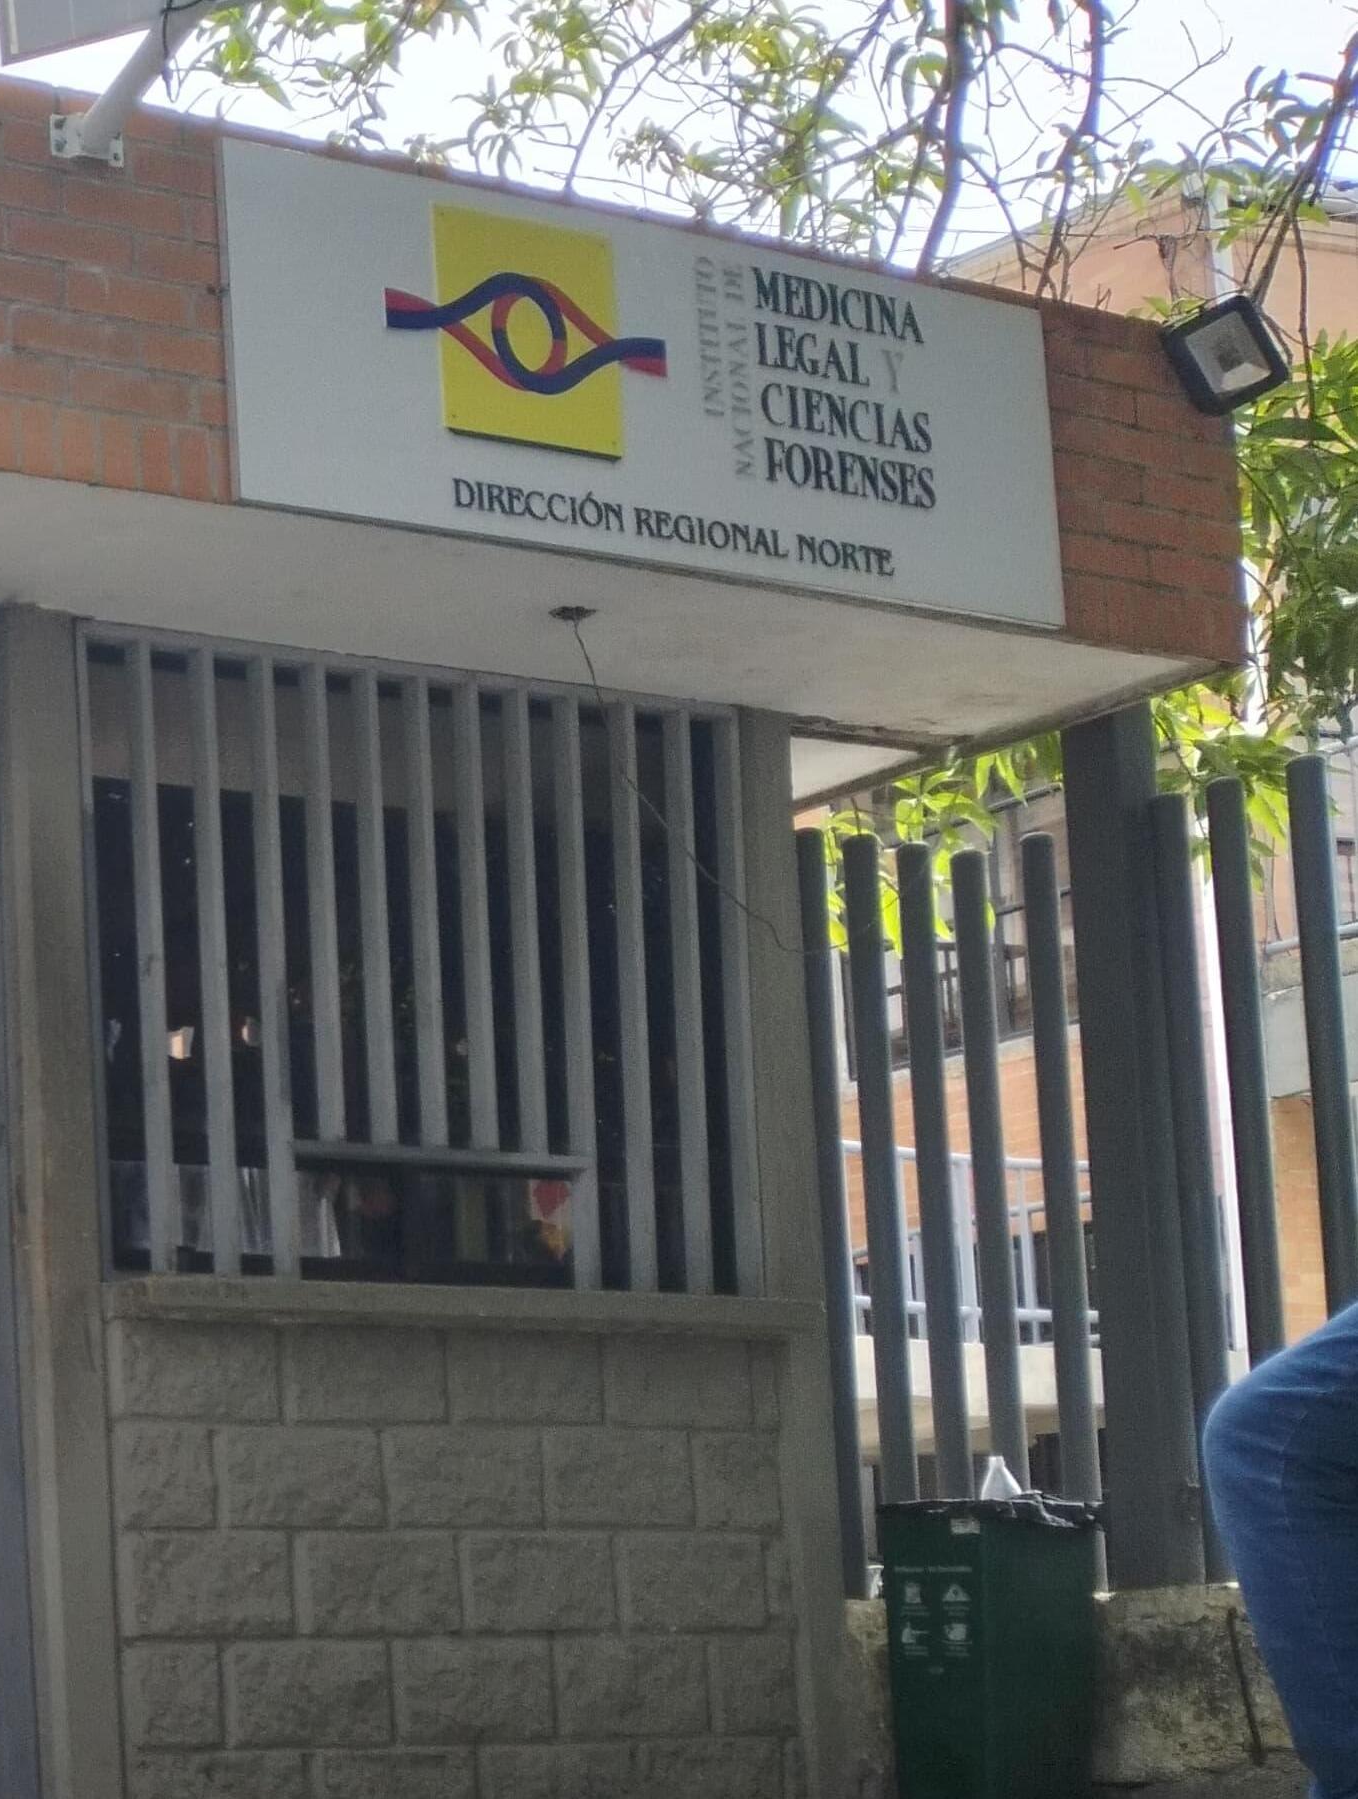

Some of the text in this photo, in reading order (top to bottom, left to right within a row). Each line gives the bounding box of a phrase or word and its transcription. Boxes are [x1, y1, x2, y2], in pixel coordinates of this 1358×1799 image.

[750, 265, 925, 344] MEDICINA
[754, 321, 905, 394] LEGAL Y
[760, 382, 933, 454] CIENCIAS
[764, 436, 937, 510] FORENSES
[452, 477, 896, 577] DIRECCIÓN REGIONAL NORTE
